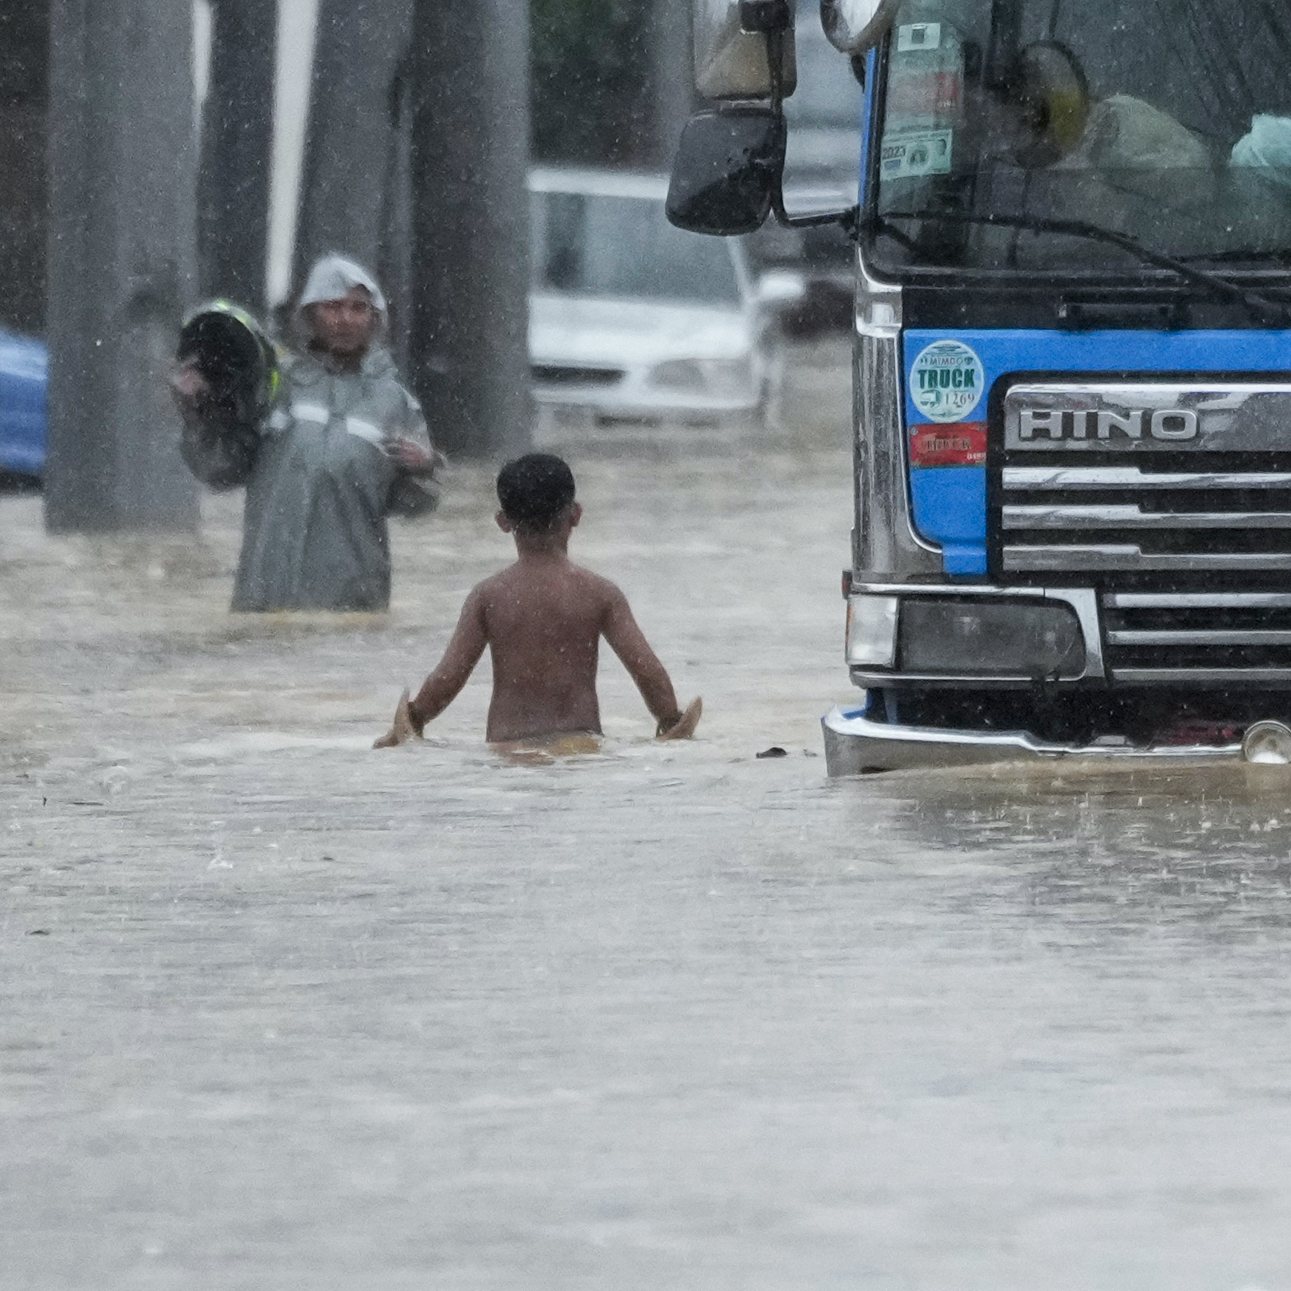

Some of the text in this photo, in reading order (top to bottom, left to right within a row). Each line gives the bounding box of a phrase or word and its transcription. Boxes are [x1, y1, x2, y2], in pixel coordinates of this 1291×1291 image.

[918, 369, 975, 389] TRUCK
[945, 392, 975, 405] 1269
[1020, 409, 1198, 440] HINO
